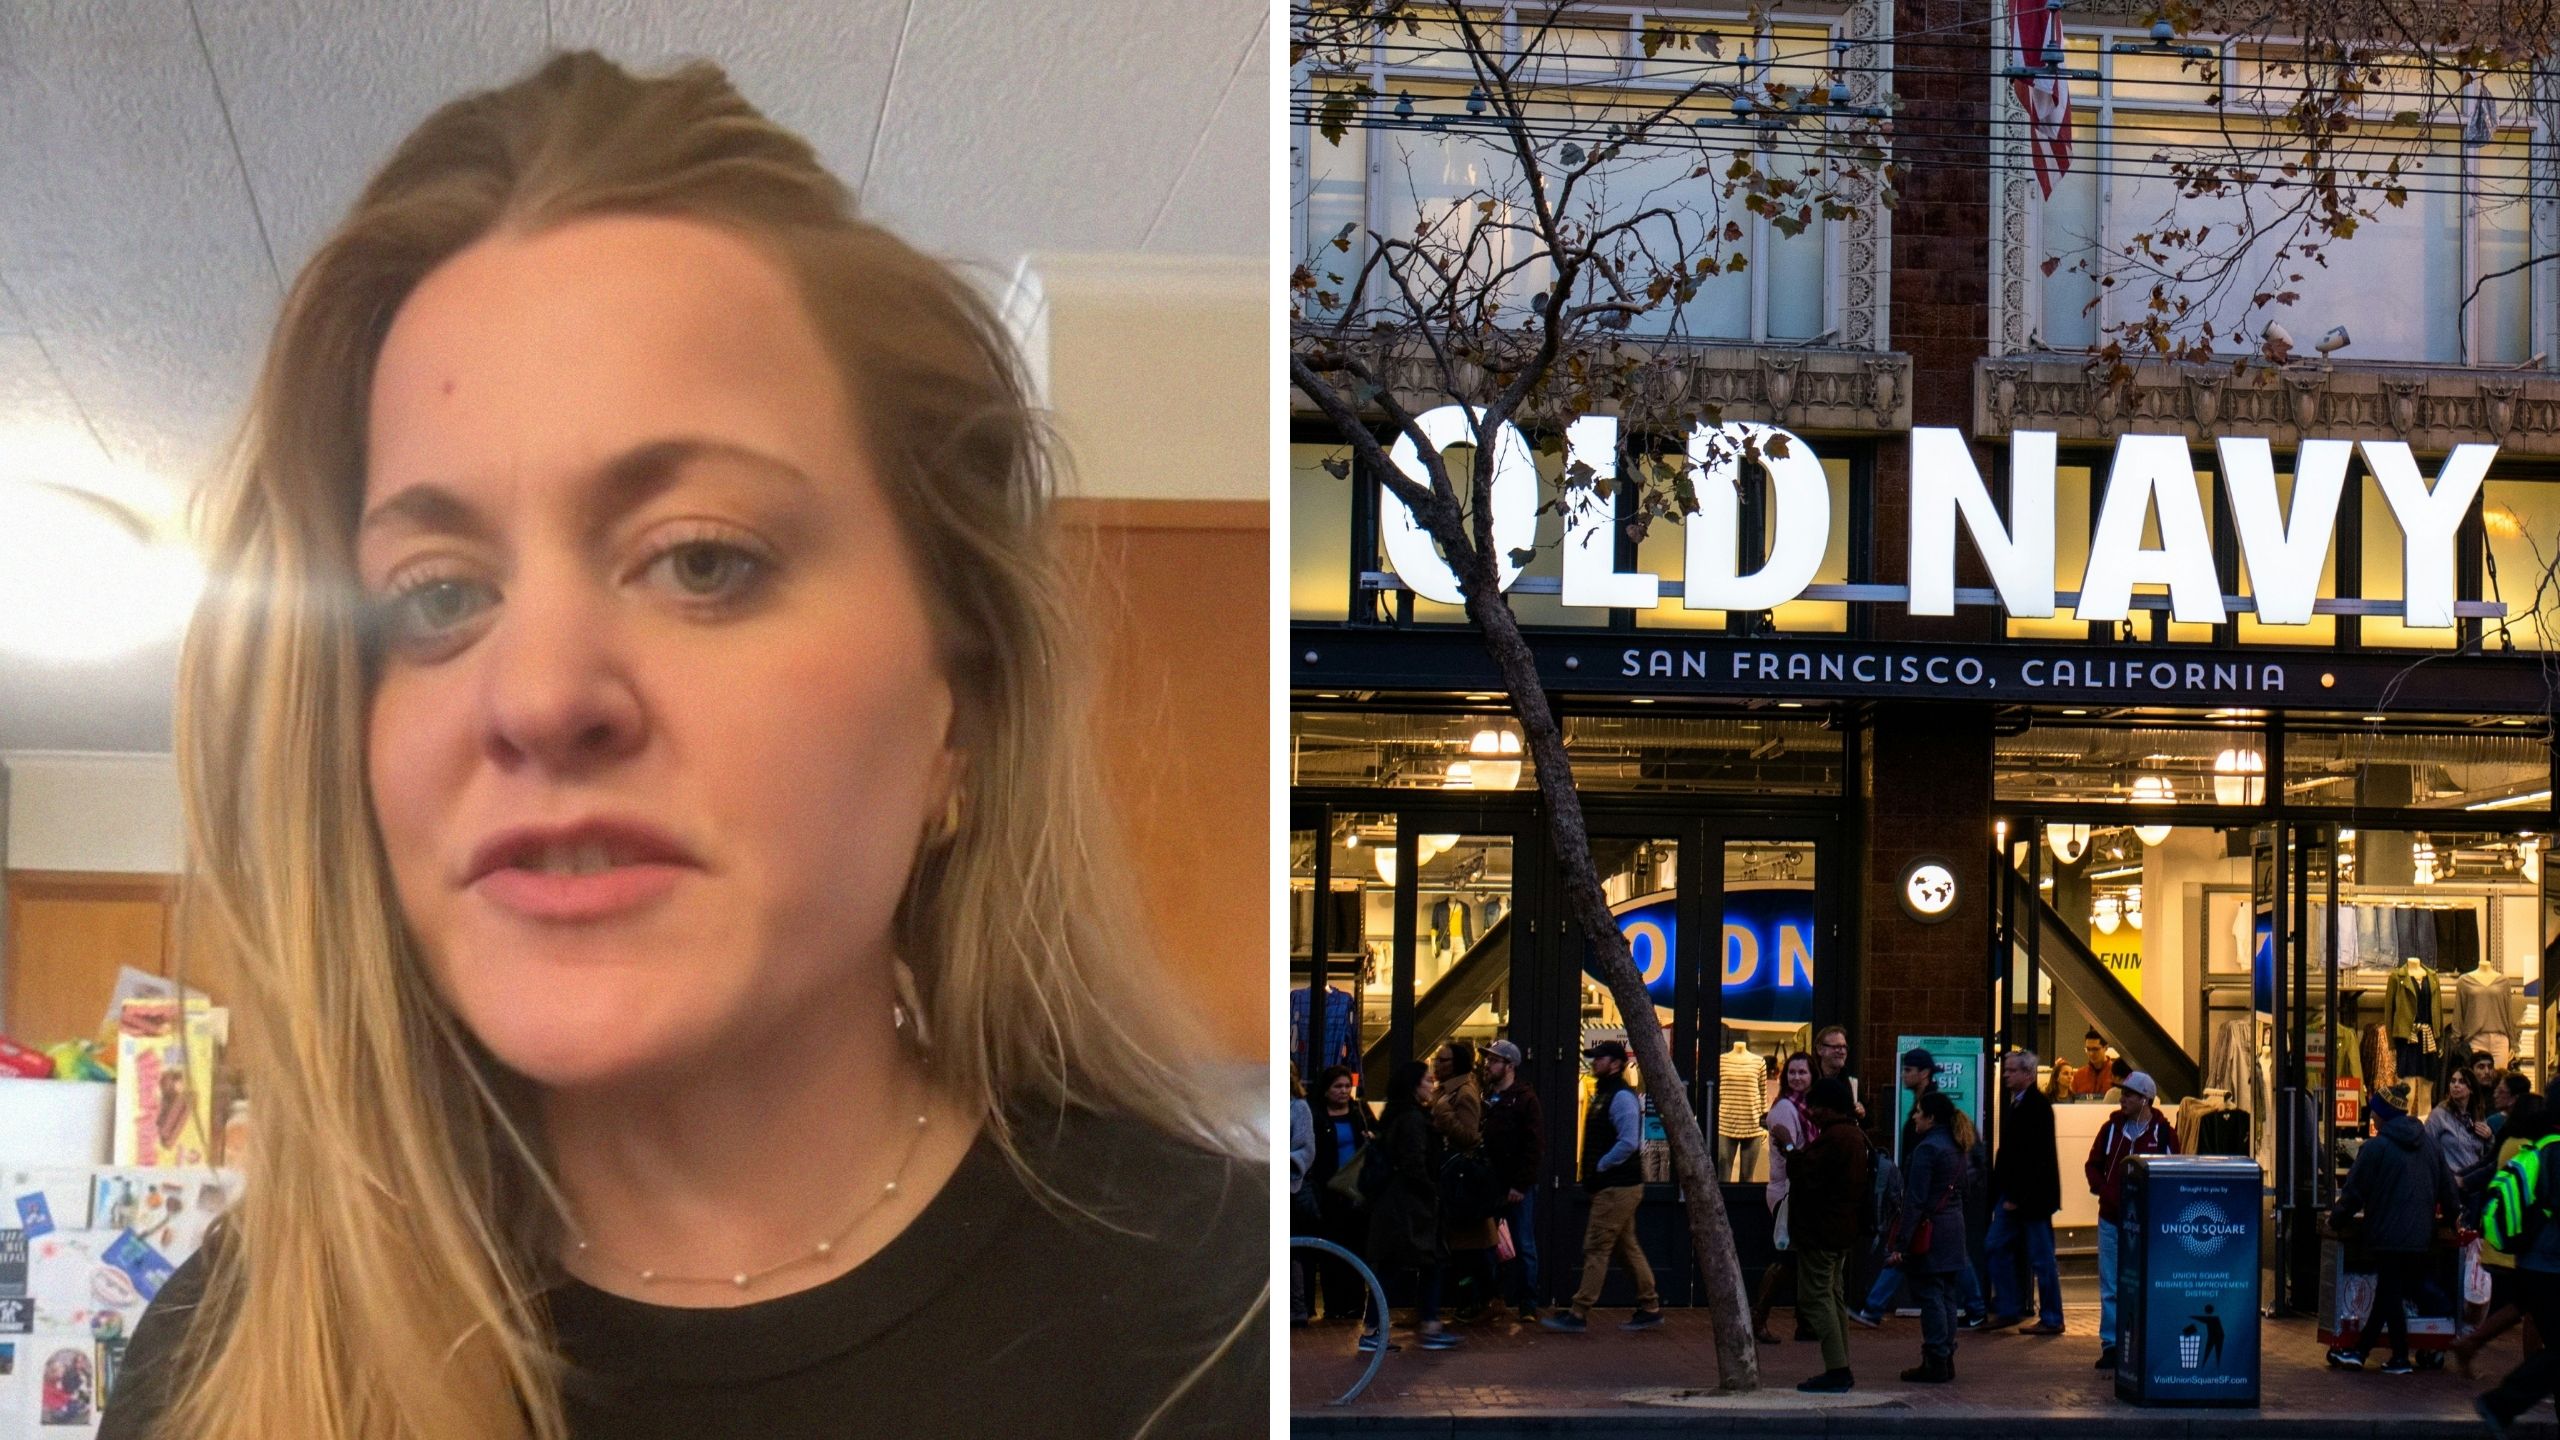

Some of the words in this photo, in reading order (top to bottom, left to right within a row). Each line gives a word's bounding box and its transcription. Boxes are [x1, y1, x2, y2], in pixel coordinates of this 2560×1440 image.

[1380, 404, 1830, 611] OLD
[1907, 426, 2500, 628] NAVY
[1621, 649, 1707, 678] SAN
[1732, 651, 1997, 689] FRANCISCO,
[2021, 660, 2285, 691] CALIFORNIA
[2099, 952, 2143, 969] ENIM
[2161, 1224, 2199, 1234] UNION
[2202, 1224, 2246, 1235] SQUARE
[2172, 1272, 2198, 1280] UNION
[2199, 1272, 2230, 1280] SQUARE
[2154, 1375, 2248, 1385] VisitUnionSquareSF.com
